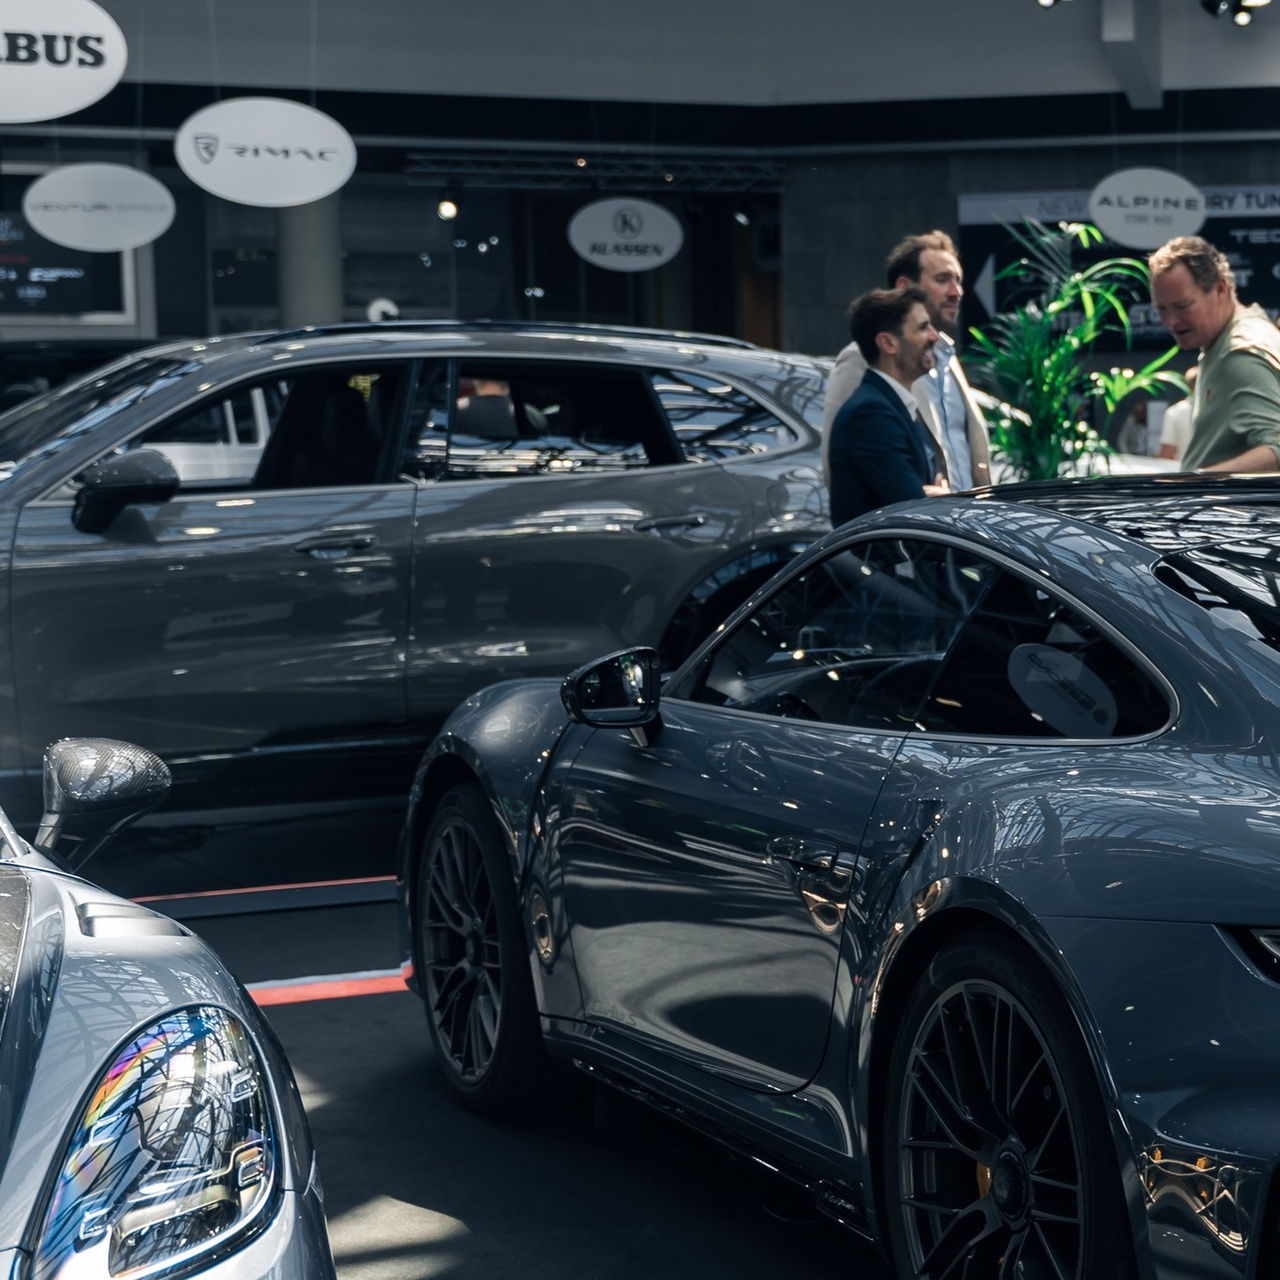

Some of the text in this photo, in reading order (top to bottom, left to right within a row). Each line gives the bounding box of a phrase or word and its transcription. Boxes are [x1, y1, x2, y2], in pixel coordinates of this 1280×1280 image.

[0, 32, 105, 67] BUS
[1099, 196, 1200, 211] ALPINE
[589, 243, 664, 258] KLASSEN
